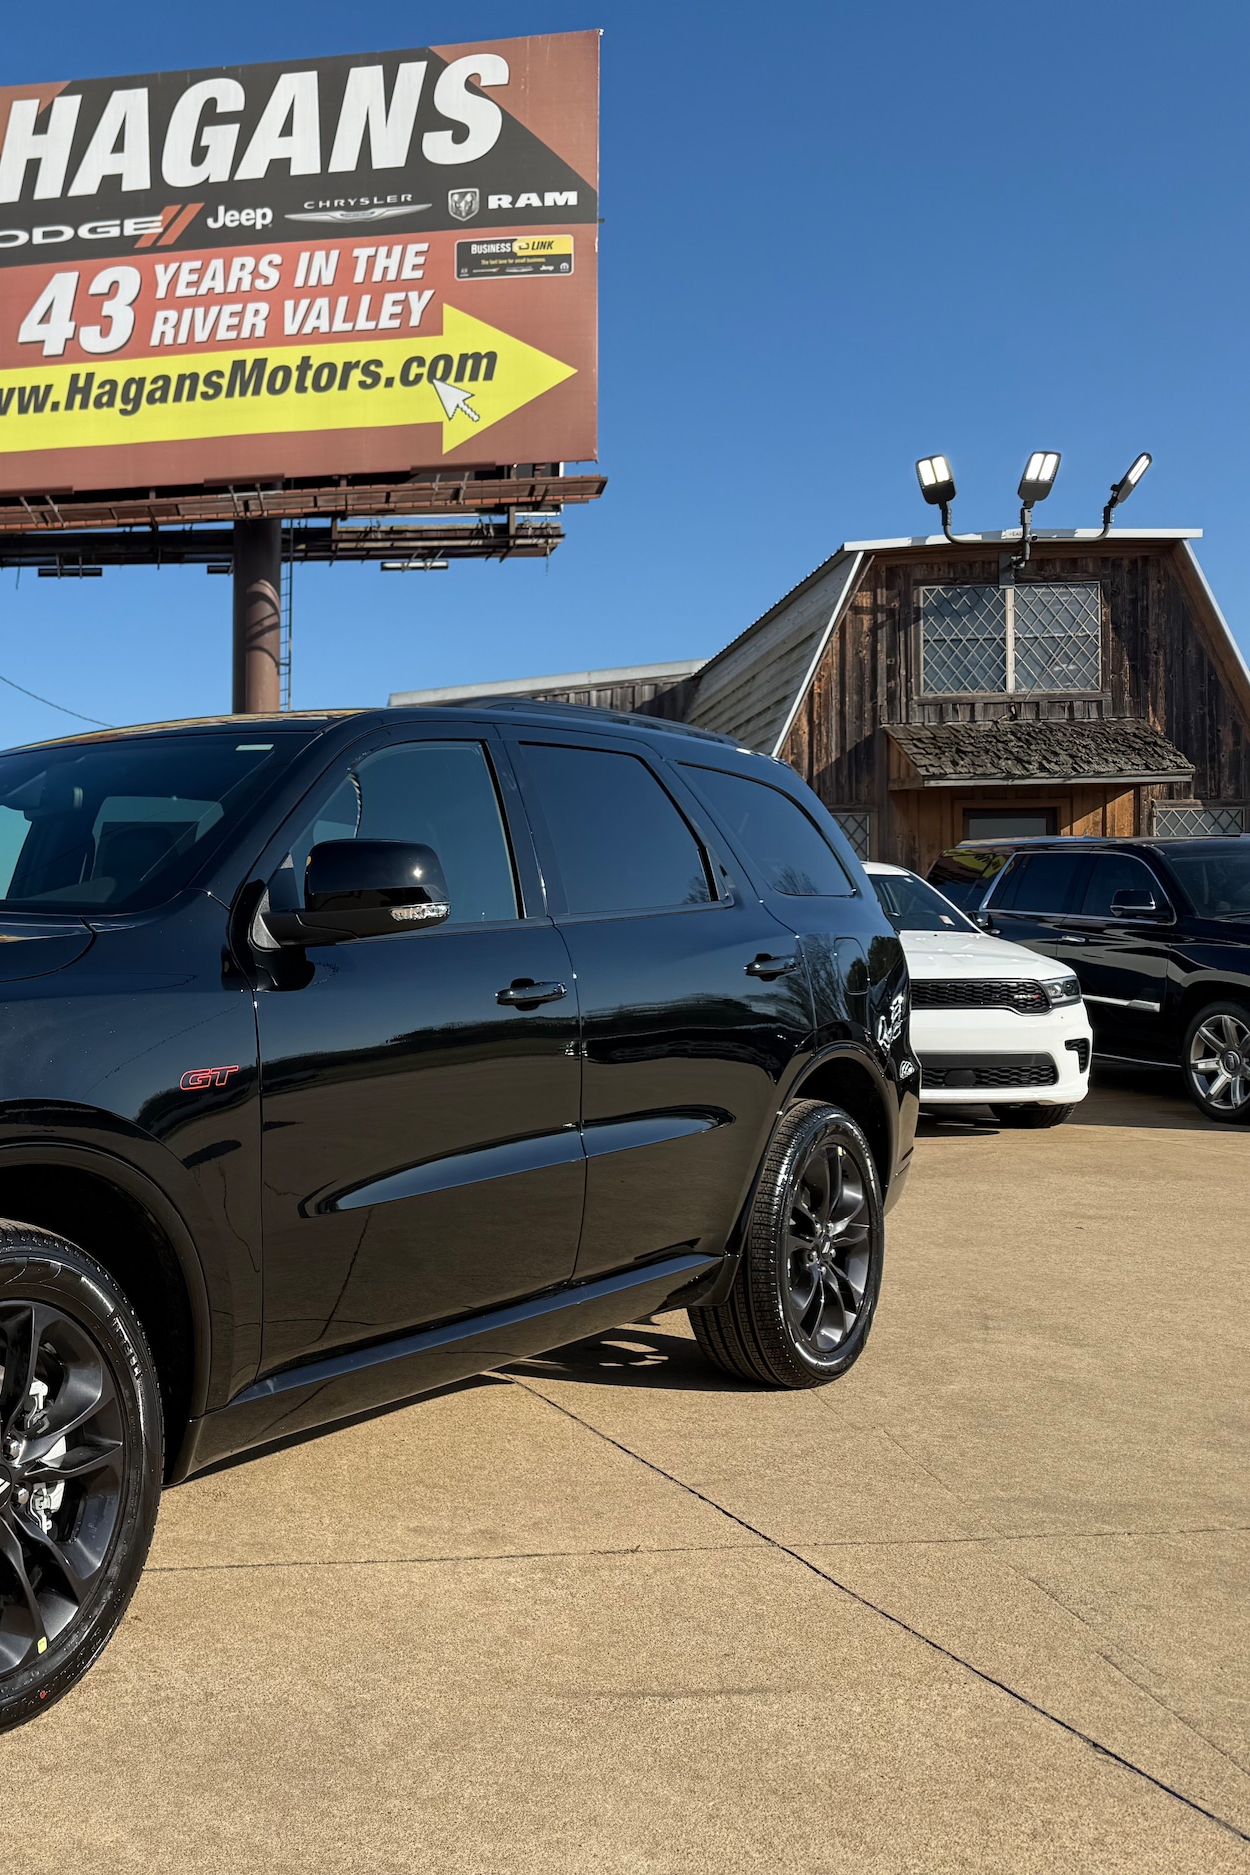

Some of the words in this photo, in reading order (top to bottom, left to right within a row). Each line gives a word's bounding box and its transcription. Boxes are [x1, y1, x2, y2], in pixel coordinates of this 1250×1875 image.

[303, 194, 413, 209] CHRYSLER
[487, 191, 578, 210] RAM
[206, 205, 273, 230] Jeep
[470, 242, 511, 255] BUSINESS
[531, 240, 554, 250] LINK
[154, 253, 282, 299] YEARS
[294, 249, 340, 288] IN
[352, 242, 430, 284] THE
[17, 265, 141, 357] 43
[149, 301, 270, 347] RIVER
[283, 290, 435, 336] VALLEY
[179, 1065, 240, 1091] GT
